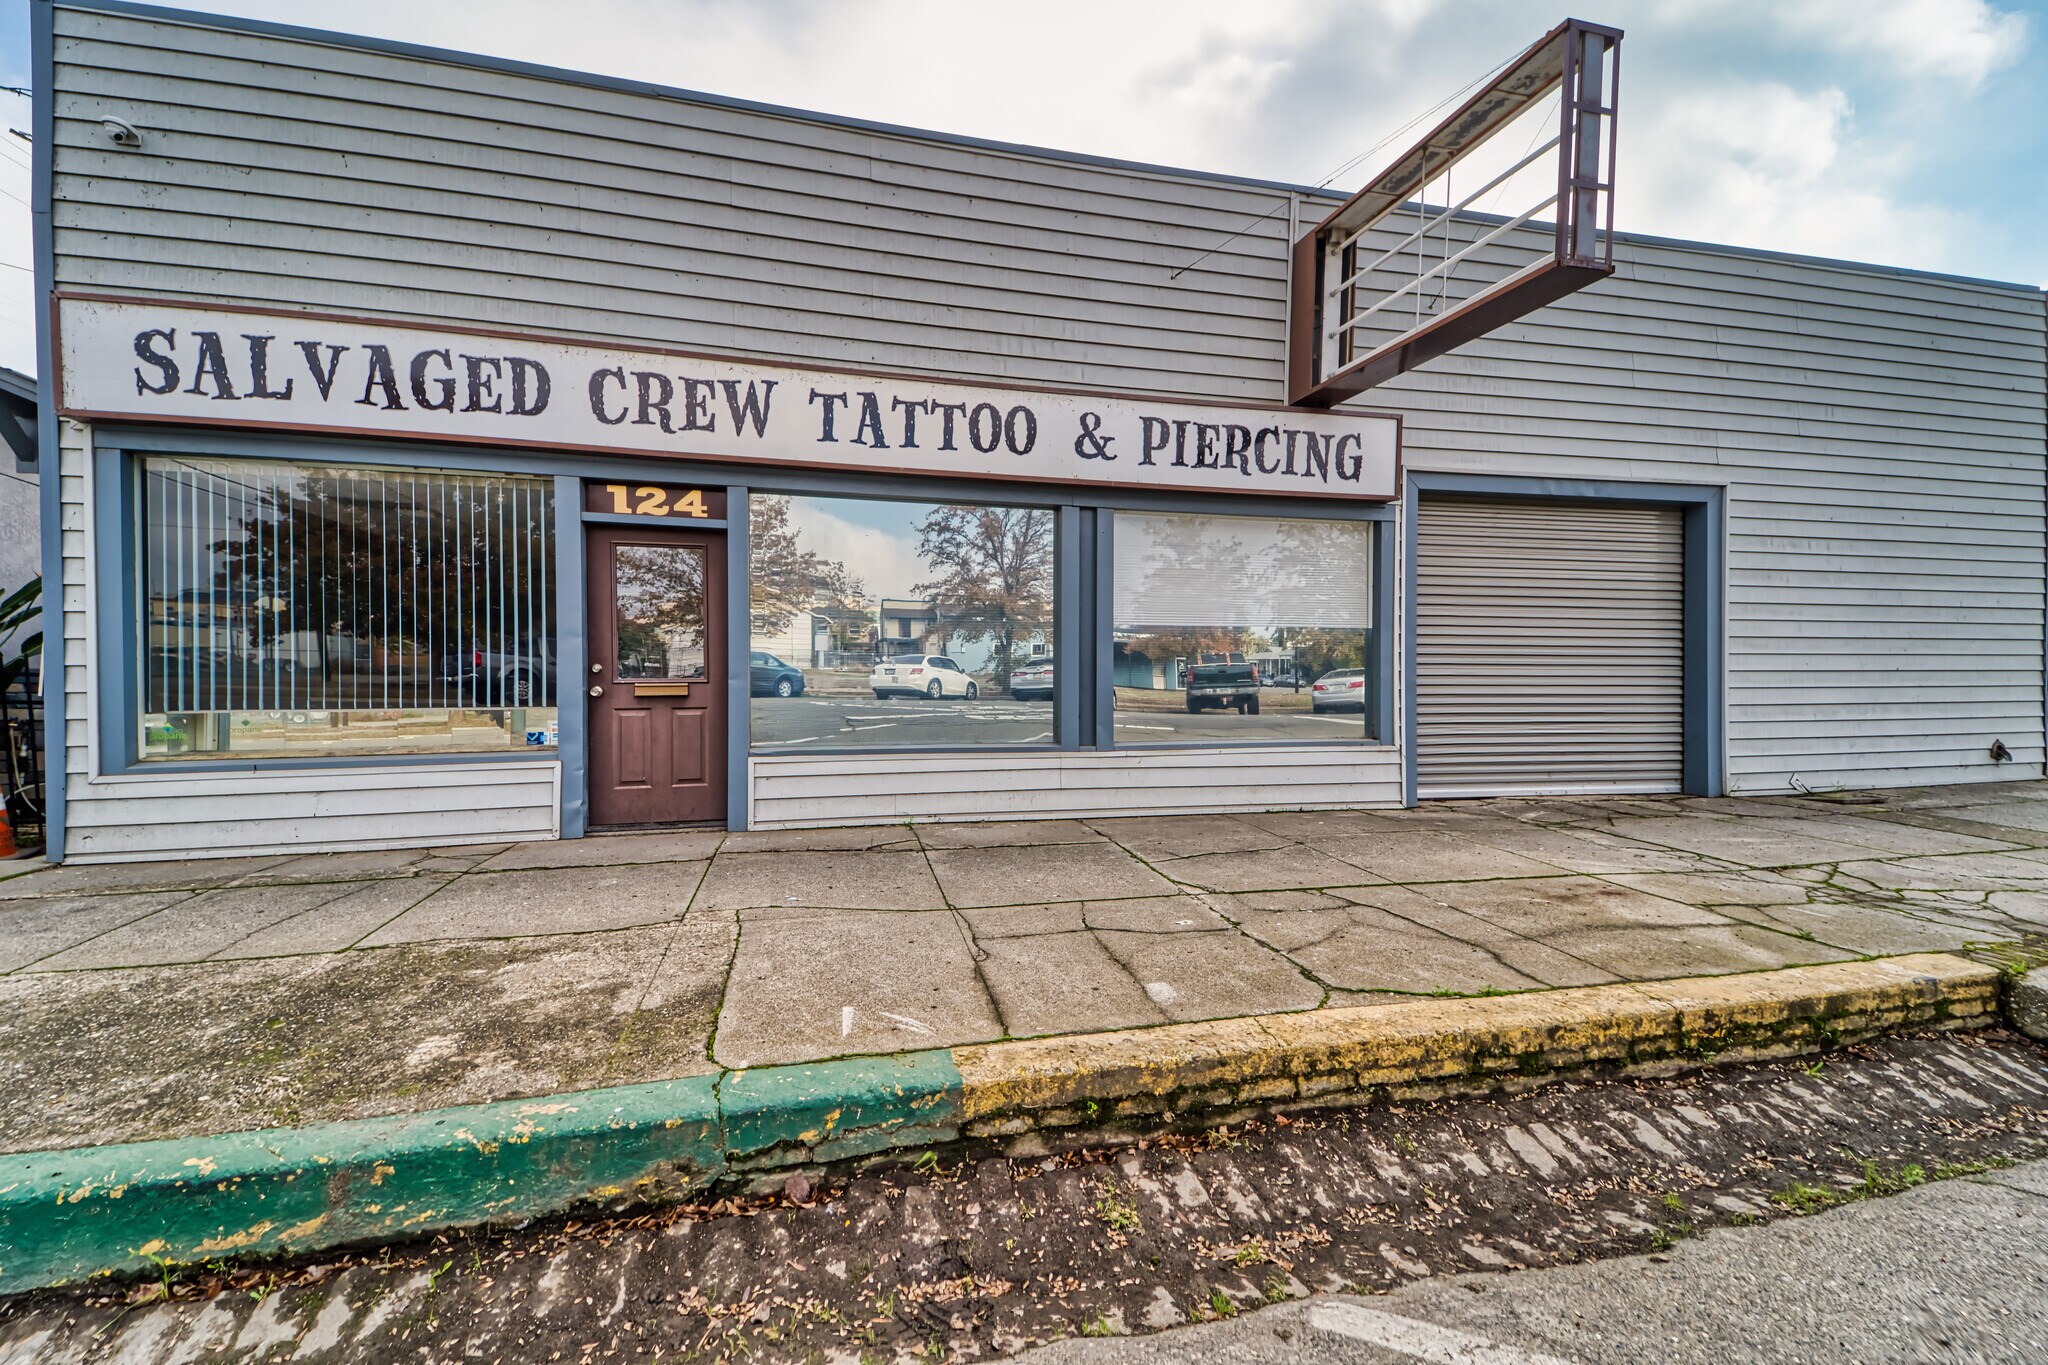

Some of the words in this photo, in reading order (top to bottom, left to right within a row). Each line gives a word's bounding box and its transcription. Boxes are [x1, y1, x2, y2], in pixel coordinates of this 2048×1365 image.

[133, 327, 551, 417] SALVAGED
[588, 366, 779, 439] CREW
[808, 387, 1038, 456] TATTOO
[1074, 411, 1118, 462] &
[1137, 415, 1363, 484] PIERCING
[606, 484, 709, 518] 124
